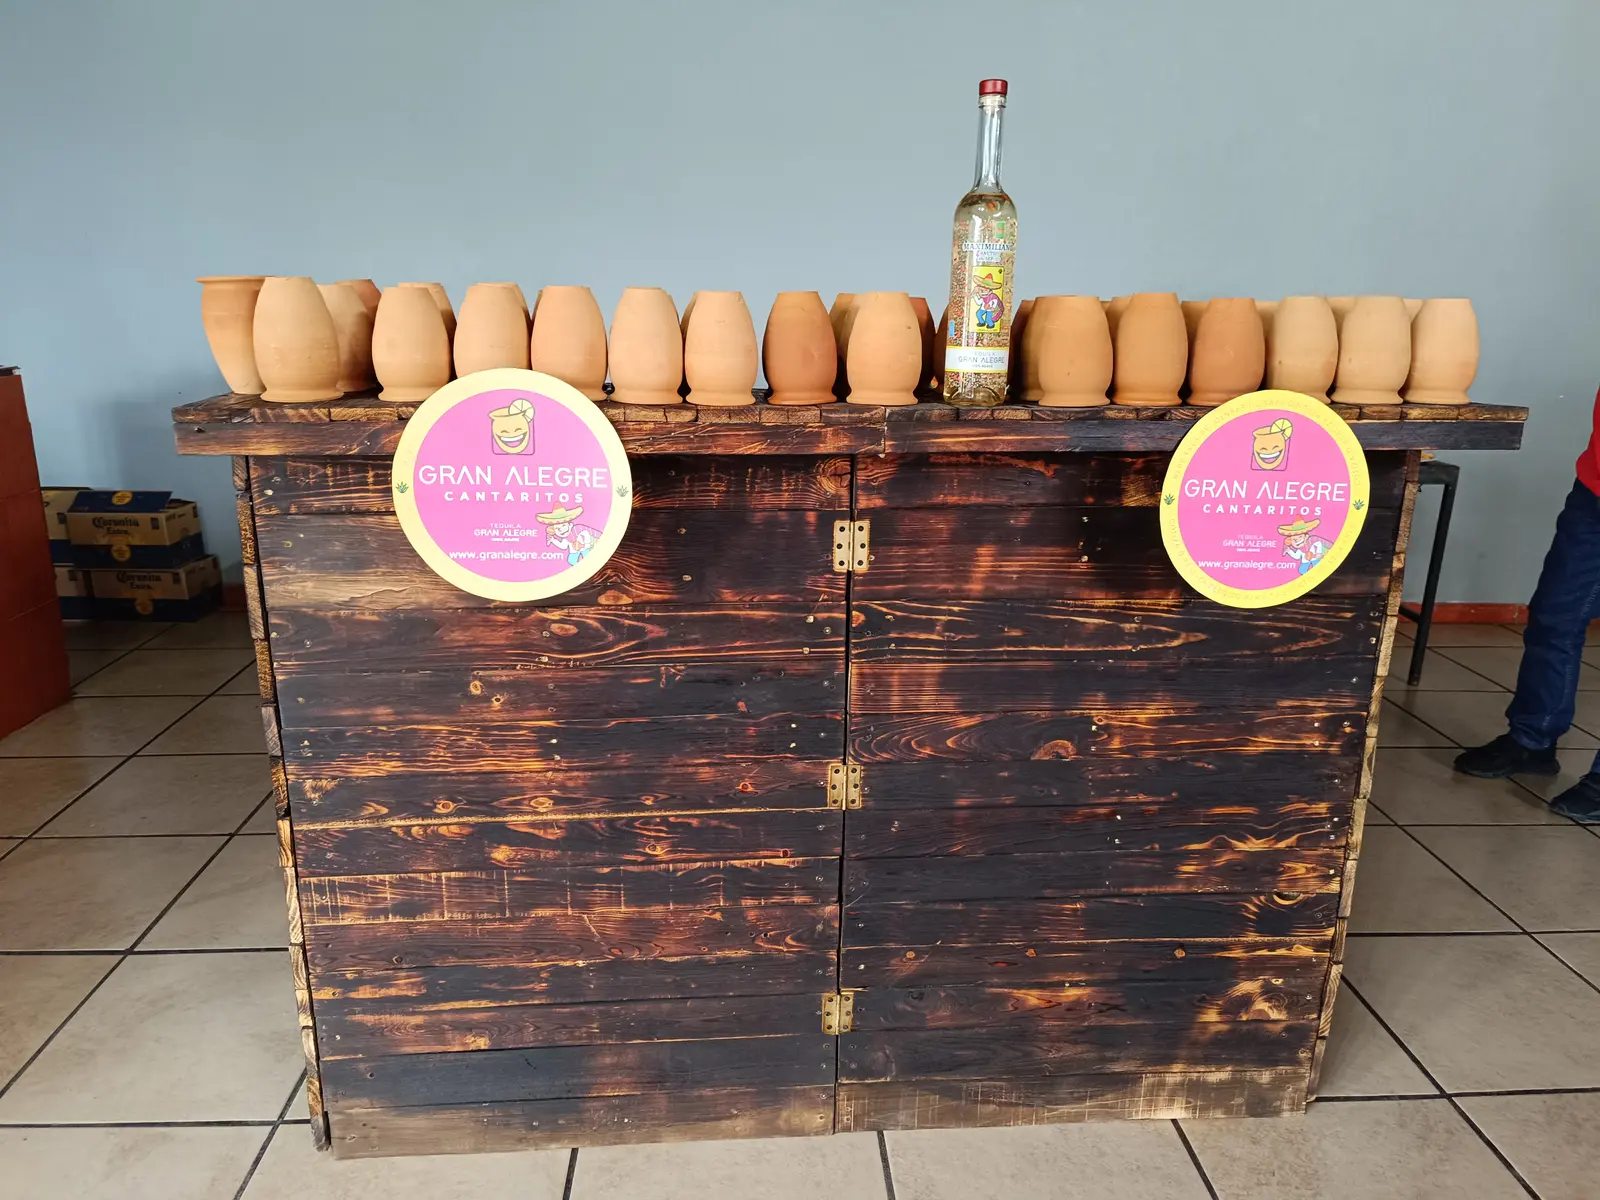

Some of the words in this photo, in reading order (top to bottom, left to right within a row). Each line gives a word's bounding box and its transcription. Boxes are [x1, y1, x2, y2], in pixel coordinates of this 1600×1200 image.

[980, 356, 1005, 364] ALEGRE
[418, 465, 492, 485] GRAN
[505, 466, 607, 488] ALEGRE
[1184, 479, 1247, 499] GRAN
[1255, 480, 1348, 502] ALEGRE
[444, 491, 584, 503] CANTARITOS
[1203, 504, 1322, 516] CANTARITOS
[503, 529, 538, 537] ALEGRE
[1247, 540, 1277, 548] ALEGRE
[449, 550, 564, 561] www.granalegre.com
[1198, 560, 1296, 571] www.granalegre.com
